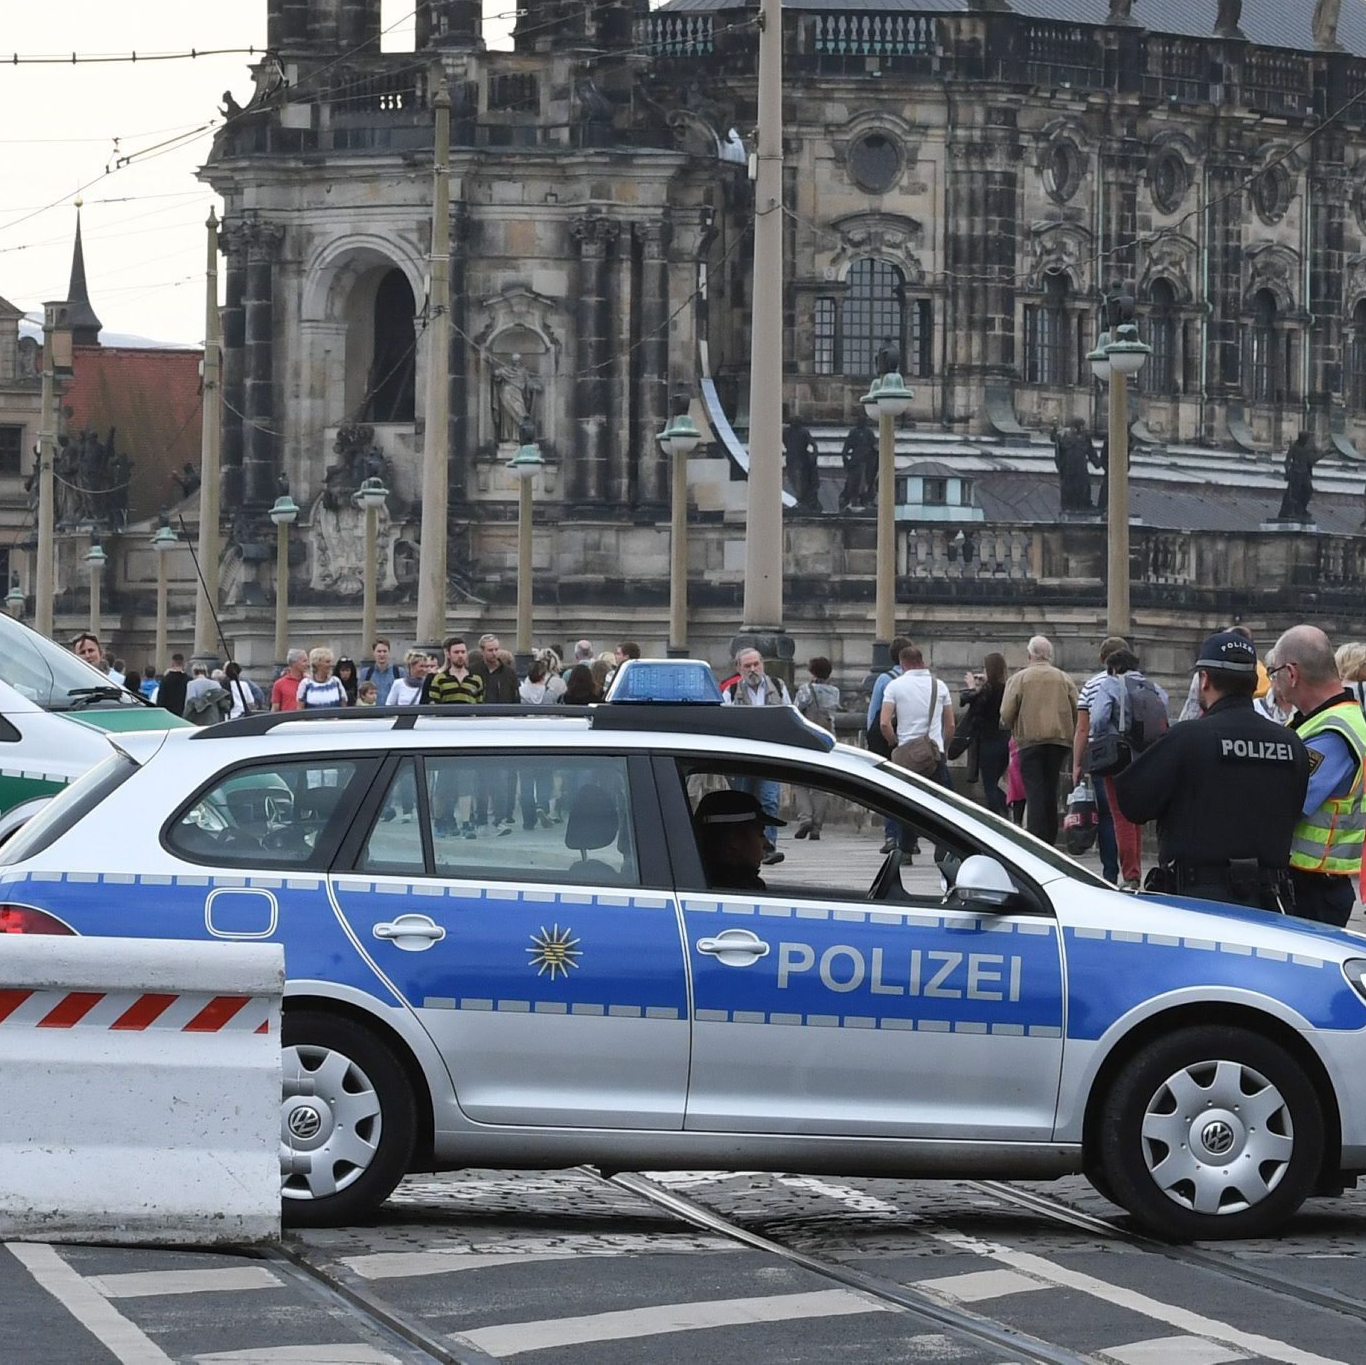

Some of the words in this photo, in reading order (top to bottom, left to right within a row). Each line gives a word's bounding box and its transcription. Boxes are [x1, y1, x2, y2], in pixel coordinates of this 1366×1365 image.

[1220, 641, 1254, 655] POLIZEI
[1221, 738, 1294, 761] POLIZEI
[777, 941, 1022, 1002] POLIZEI
